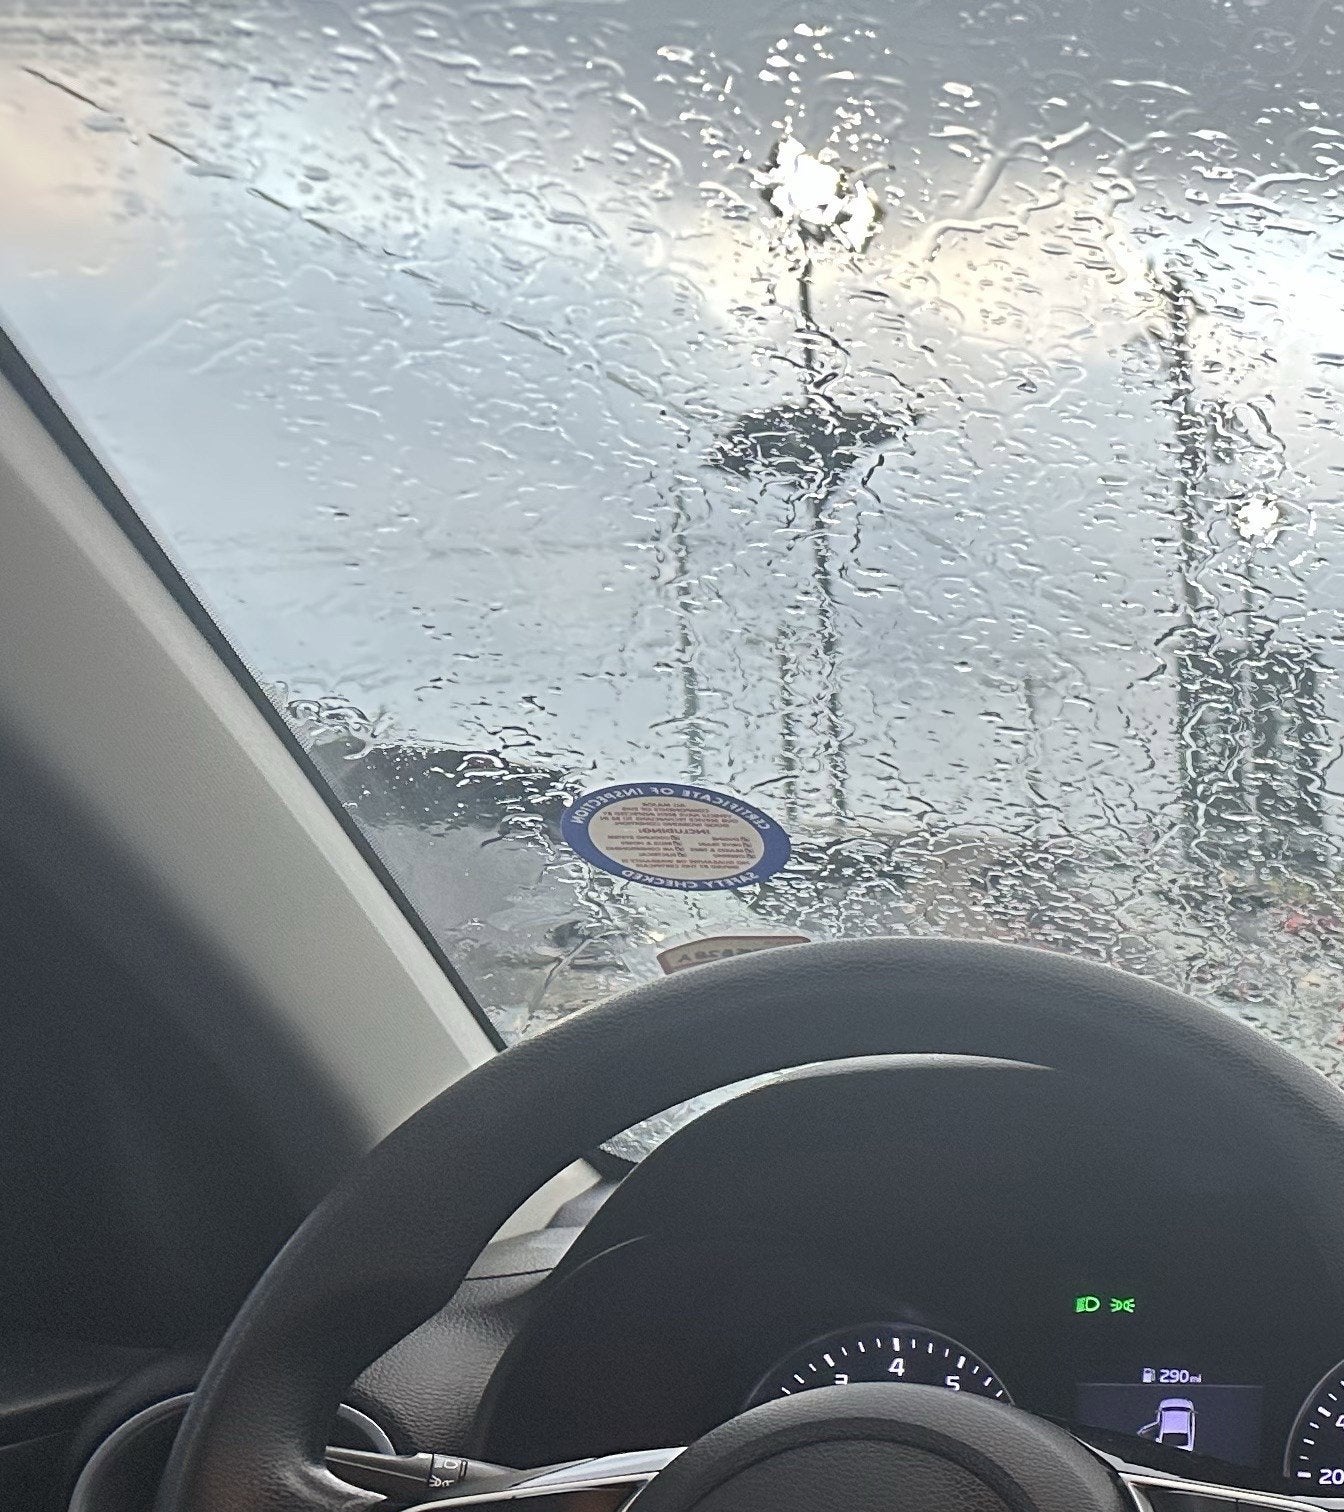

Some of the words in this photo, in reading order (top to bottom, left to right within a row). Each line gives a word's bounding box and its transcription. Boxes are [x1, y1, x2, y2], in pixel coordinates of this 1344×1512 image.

[887, 1357, 905, 1377] 4
[945, 1375, 961, 1391] 5
[1159, 1369, 1190, 1383] 290
[1319, 1469, 1344, 1484] 20
